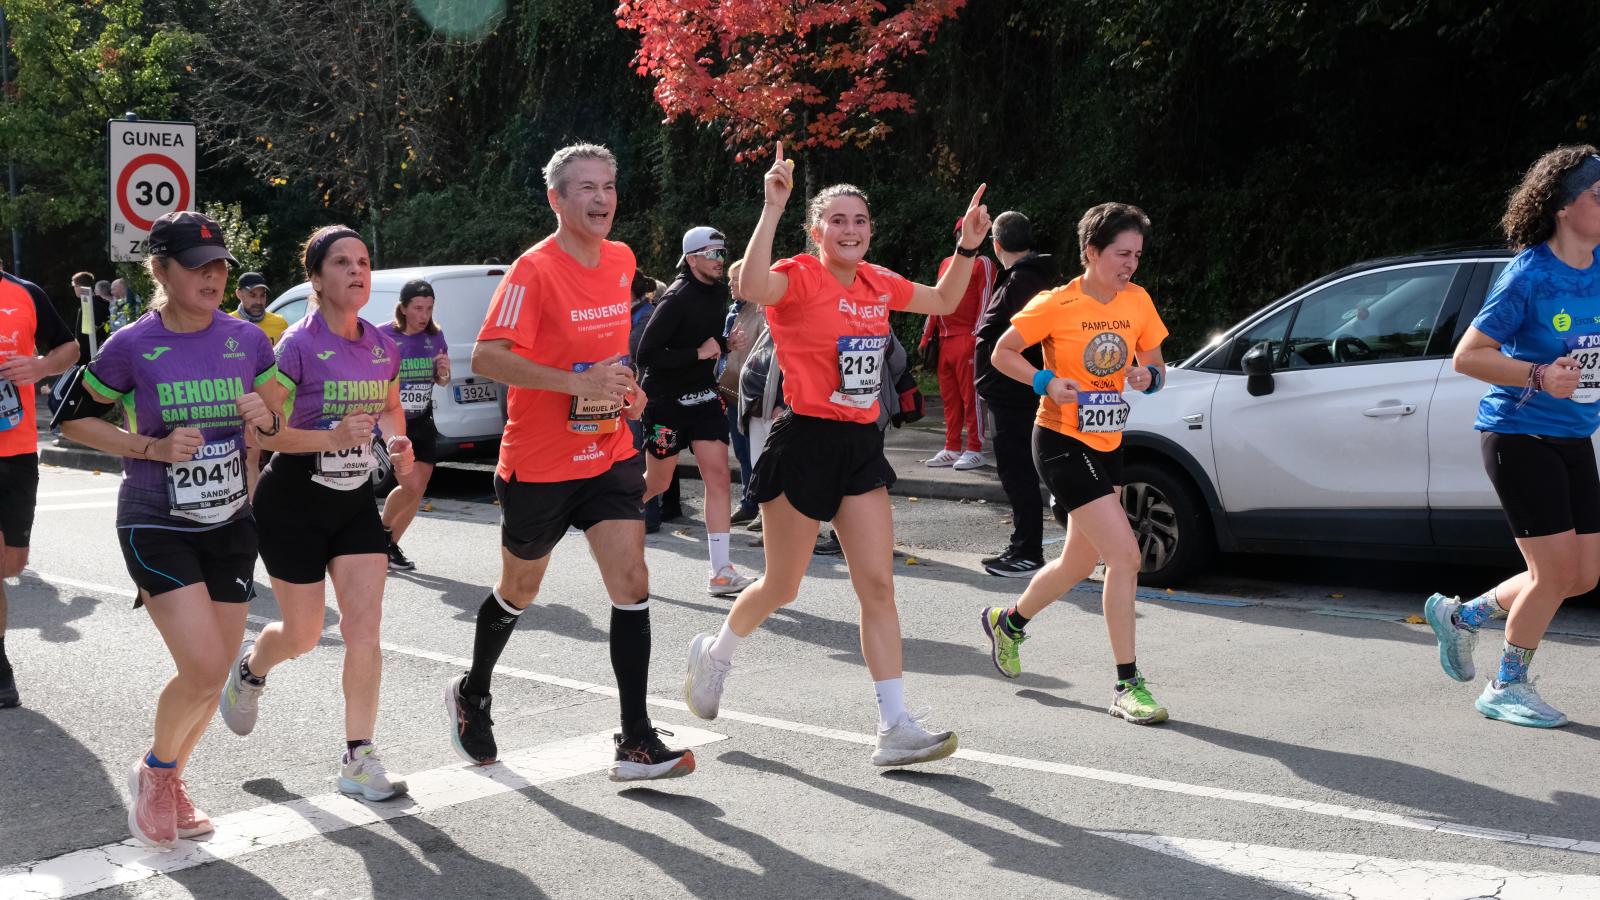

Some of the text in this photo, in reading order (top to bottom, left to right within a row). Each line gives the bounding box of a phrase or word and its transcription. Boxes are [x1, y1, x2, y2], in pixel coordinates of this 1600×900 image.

[122, 131, 184, 147] GUNEA
[135, 181, 175, 206] 30
[1082, 320, 1131, 331] PAMPLONA
[1094, 333, 1121, 345] BEER
[843, 356, 878, 375] 213
[156, 377, 244, 406] BEHOBIA
[464, 386, 490, 399] 3924
[162, 404, 238, 422] SAN SEBASTI
[322, 403, 346, 414] SAN
[583, 405, 608, 413] MIGUEL
[175, 457, 240, 488] 20470
